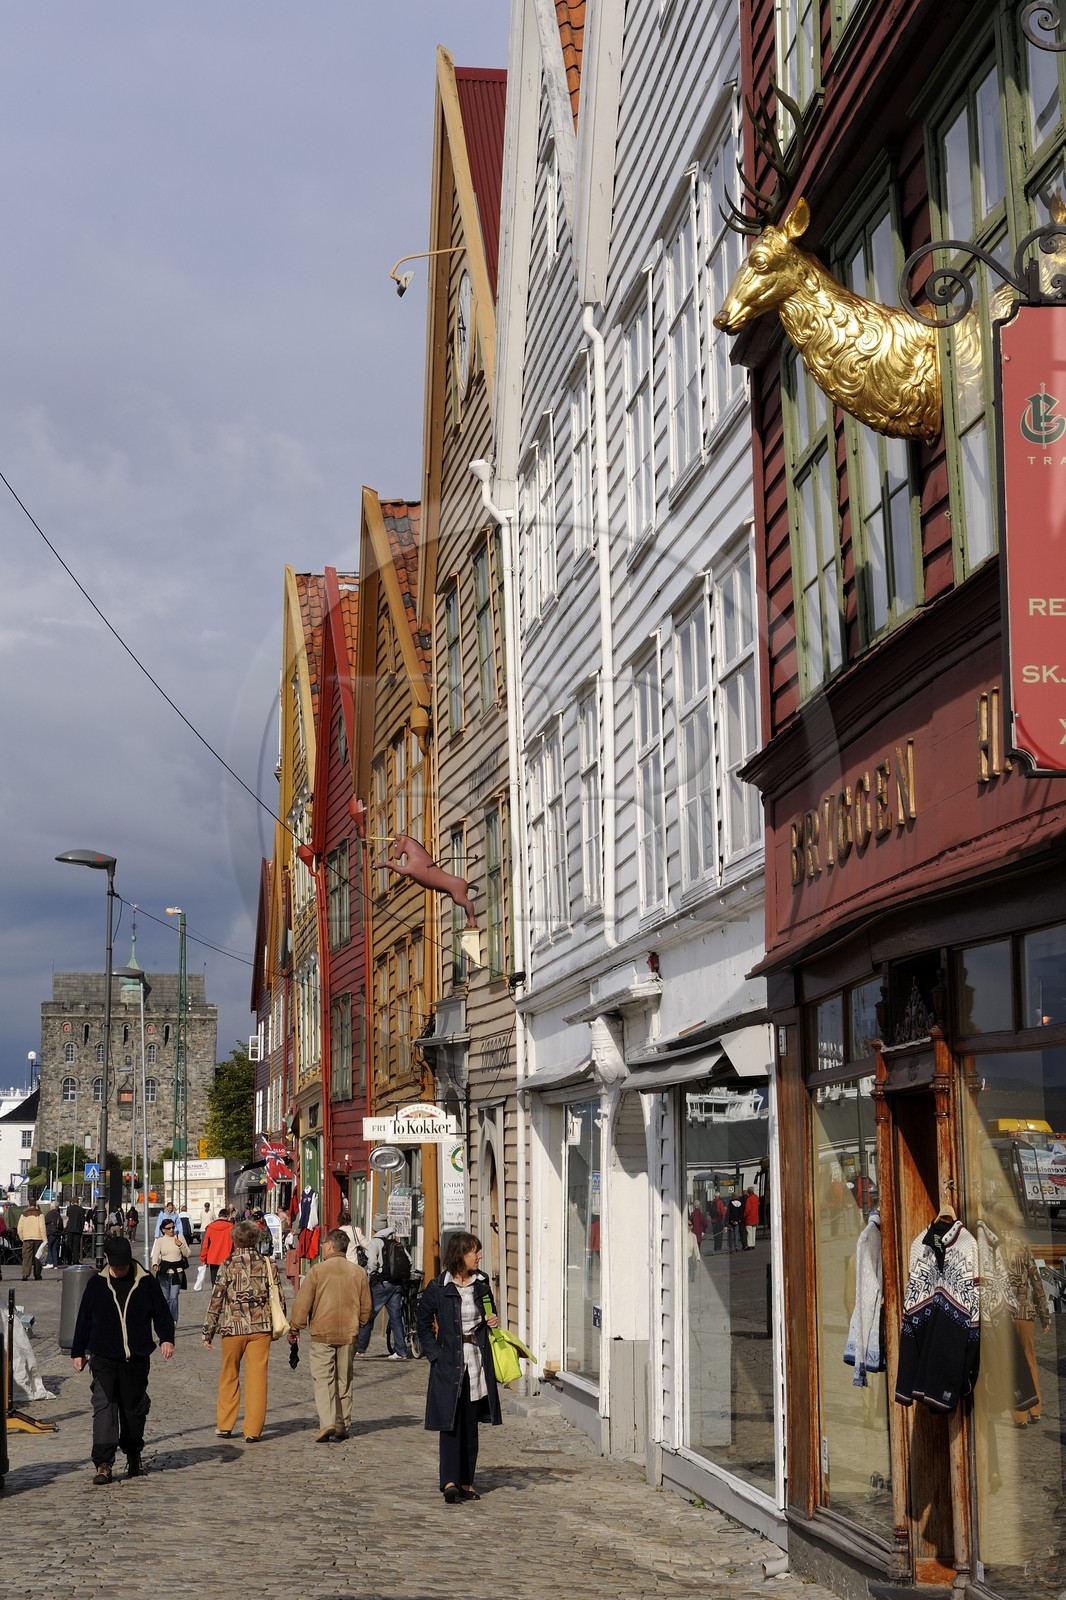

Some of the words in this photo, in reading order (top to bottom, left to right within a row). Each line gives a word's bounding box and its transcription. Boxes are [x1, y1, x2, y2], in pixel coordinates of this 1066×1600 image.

[790, 737, 917, 887] BRYGGEN
[390, 1119, 405, 1135] To
[407, 1119, 451, 1135] Kokker
